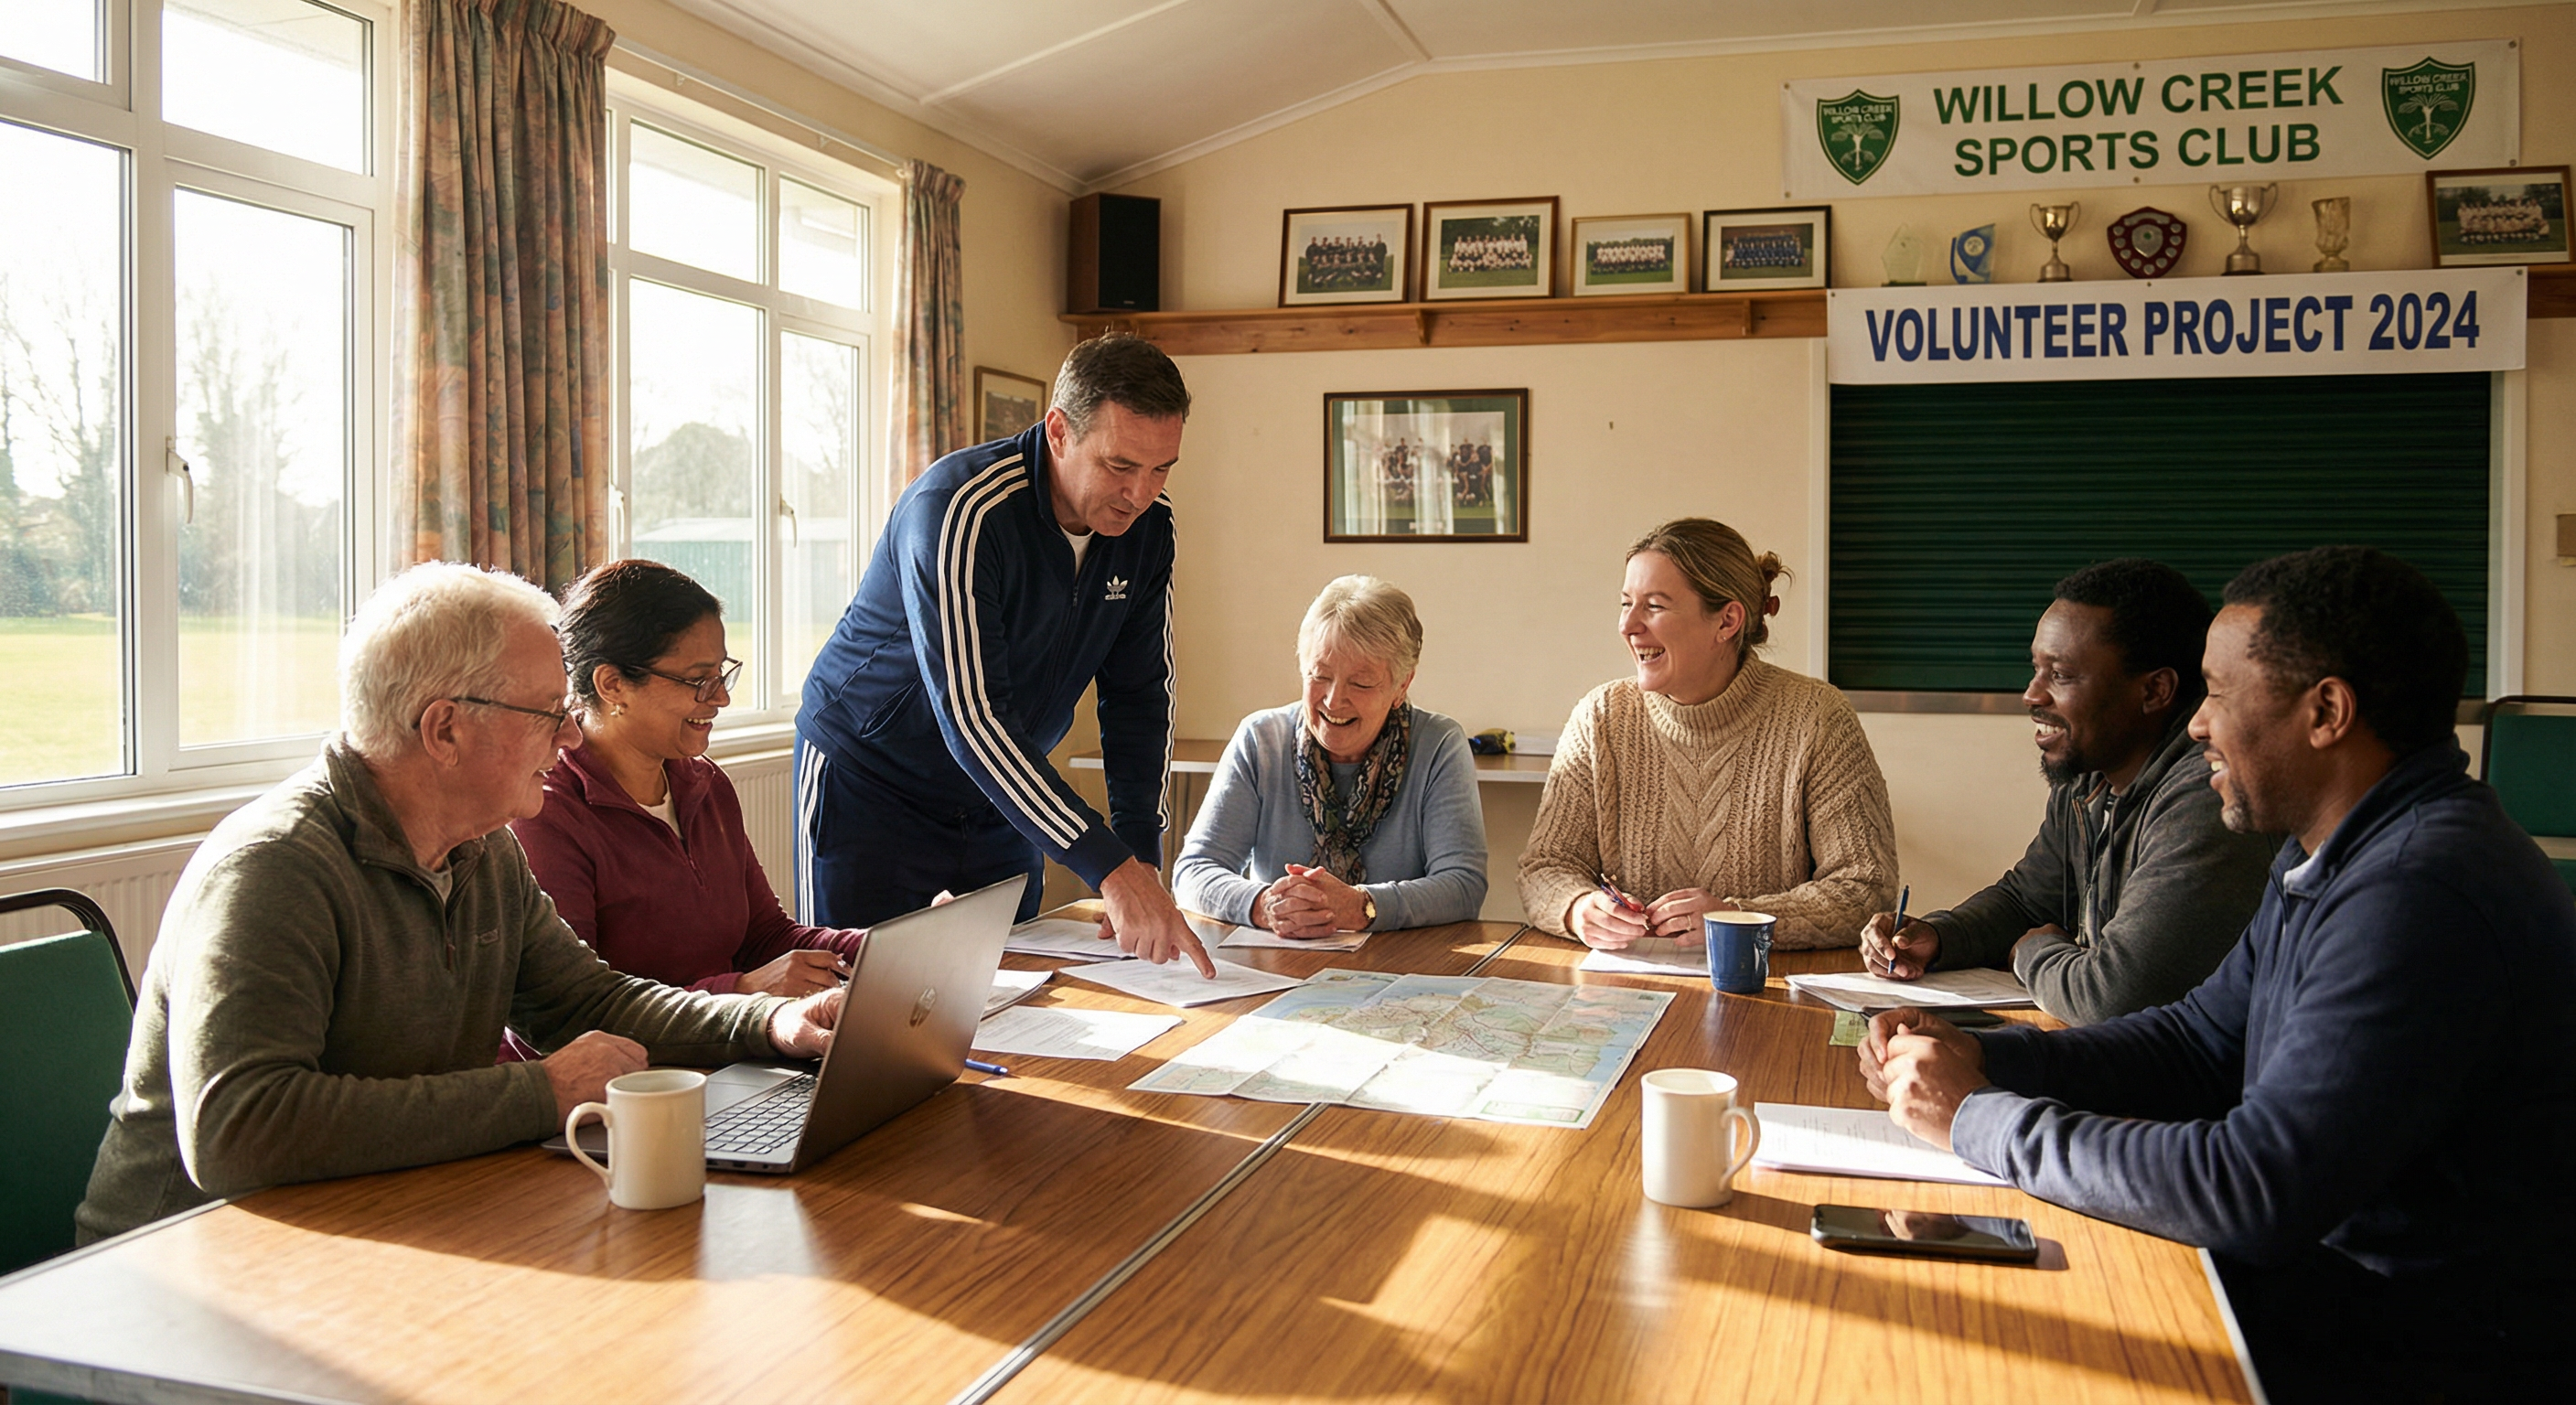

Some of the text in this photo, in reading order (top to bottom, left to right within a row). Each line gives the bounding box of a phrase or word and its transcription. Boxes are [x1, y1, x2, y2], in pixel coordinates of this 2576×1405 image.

[1933, 65, 2344, 124] WILLOW CREEK
[1955, 123, 2321, 177] SPORTS CLUB
[1865, 290, 2480, 362] VOLUNTEER PROJECT 2024
